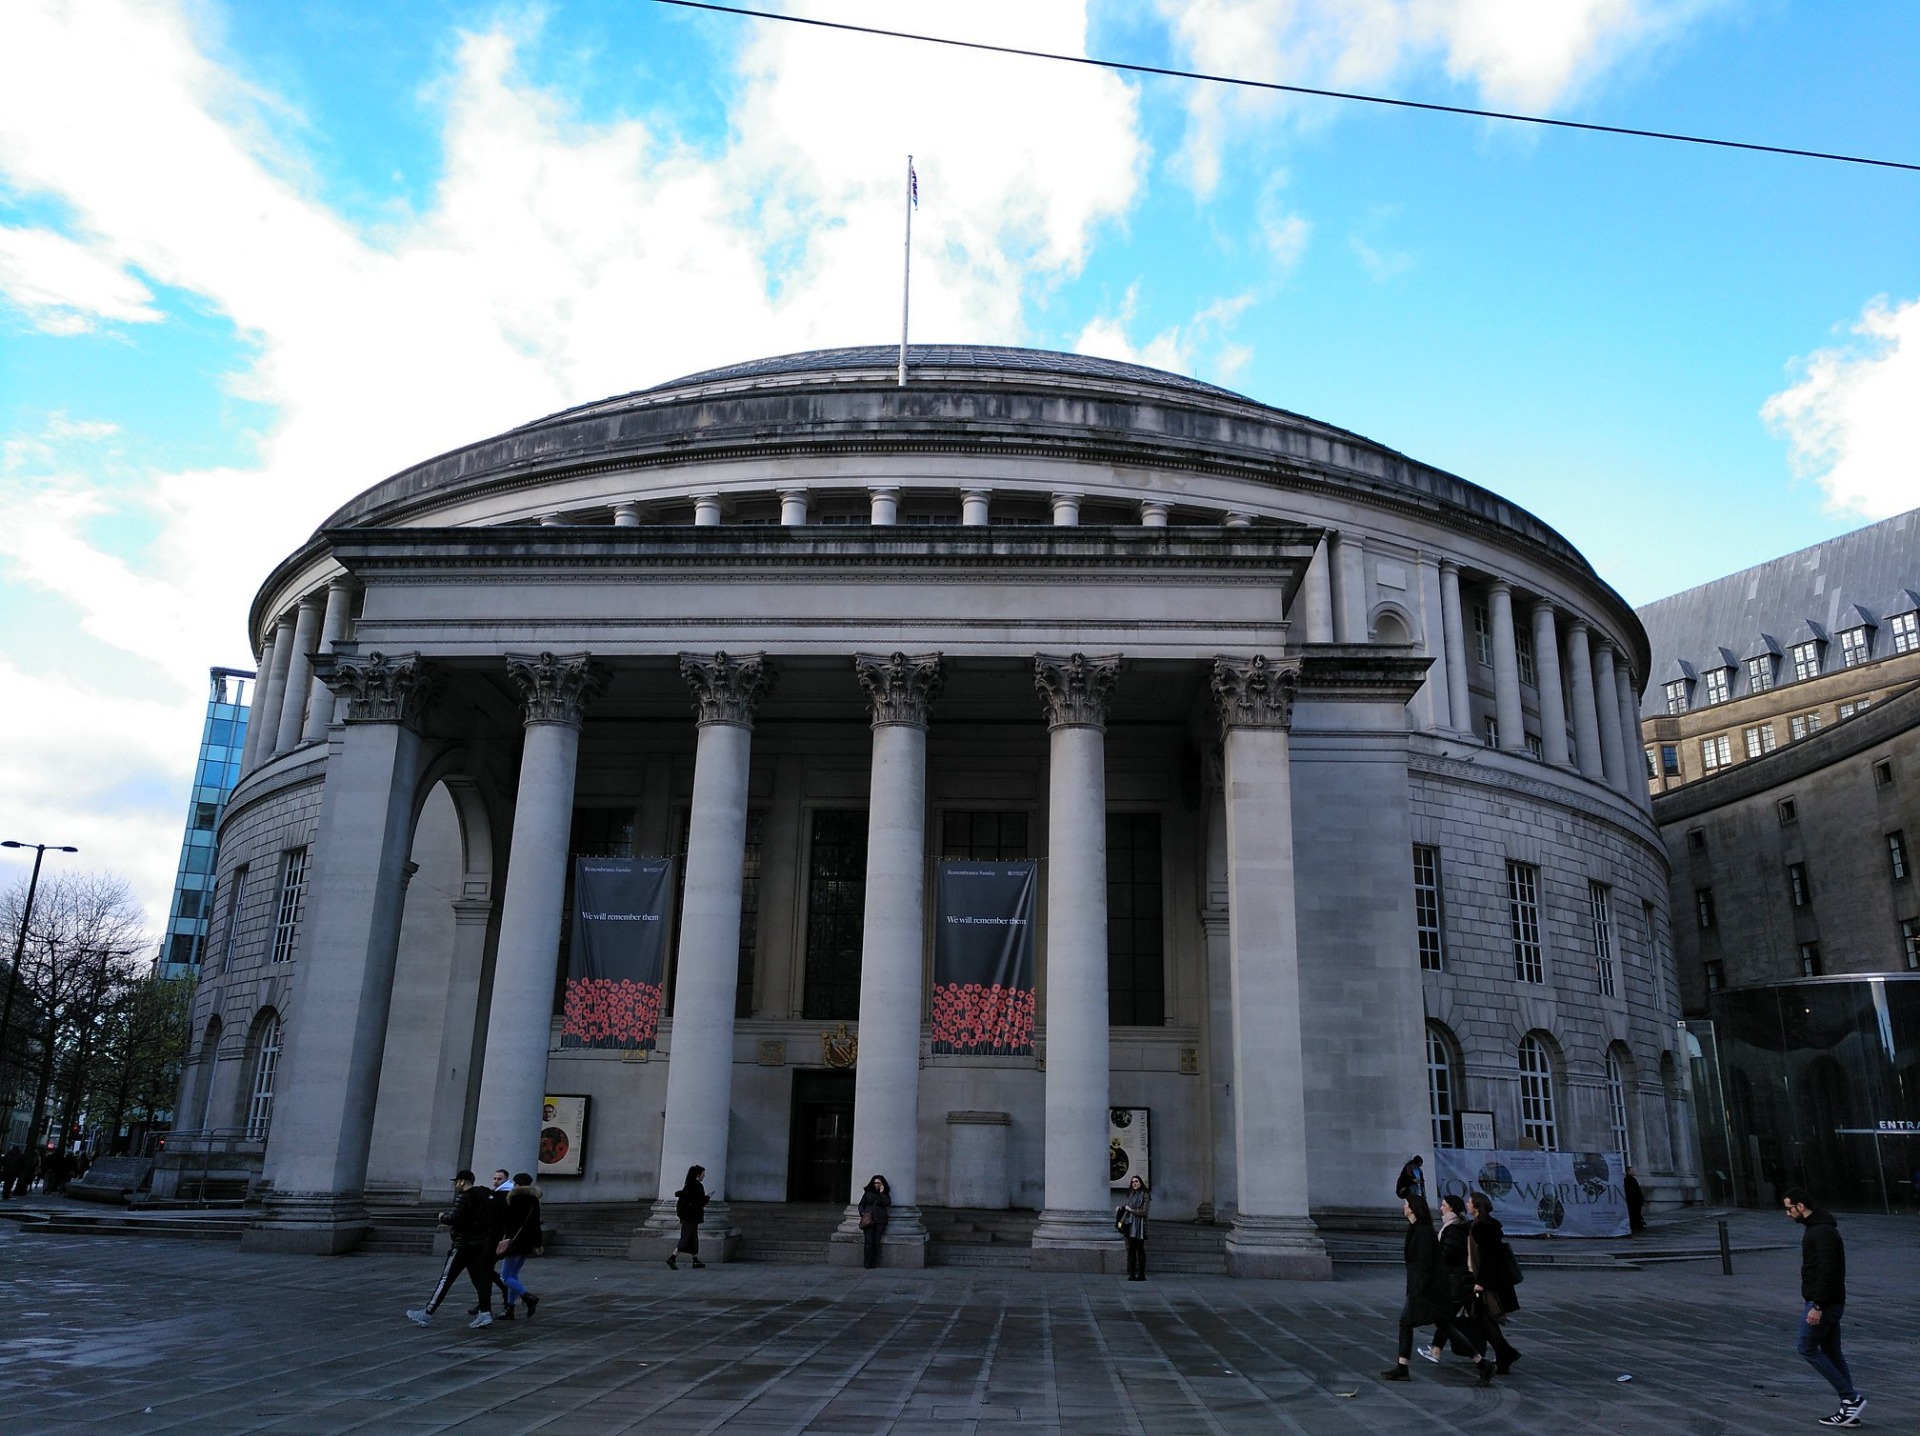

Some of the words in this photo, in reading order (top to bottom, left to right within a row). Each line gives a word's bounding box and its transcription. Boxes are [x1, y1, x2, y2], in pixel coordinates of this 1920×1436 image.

[582, 911, 593, 920] We
[594, 912, 606, 920] will
[947, 915, 958, 924] We
[960, 916, 972, 924] will
[1009, 917, 1027, 925] them
[1464, 1123, 1491, 1131] CENTRAL
[1464, 1131, 1488, 1139] LIBRARY
